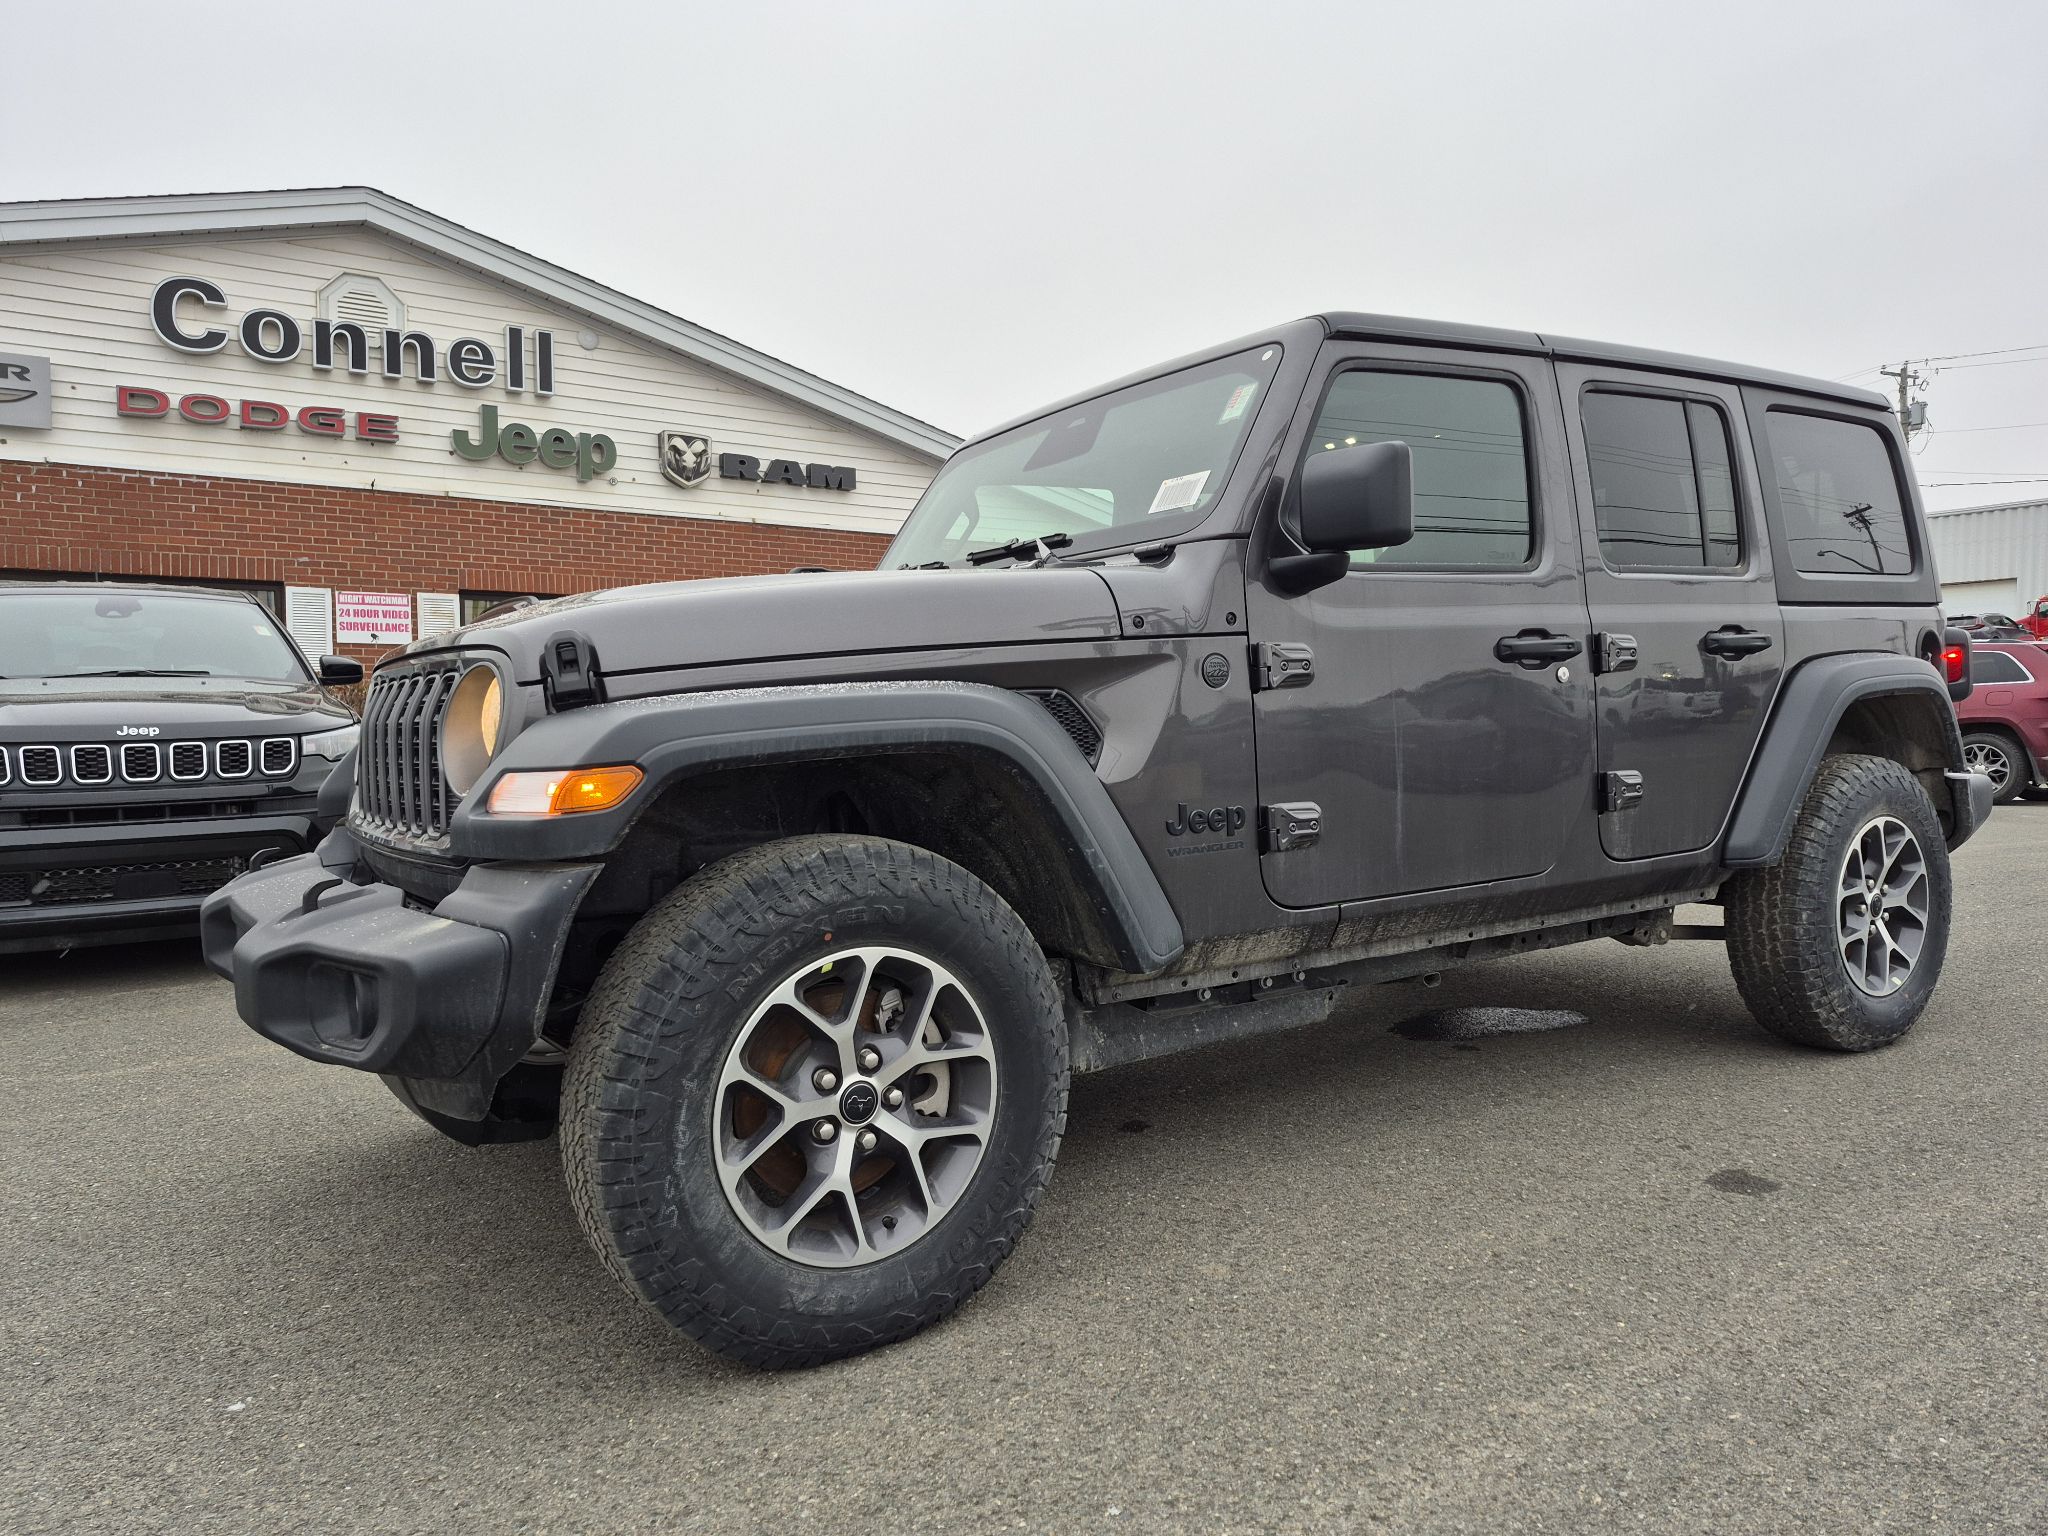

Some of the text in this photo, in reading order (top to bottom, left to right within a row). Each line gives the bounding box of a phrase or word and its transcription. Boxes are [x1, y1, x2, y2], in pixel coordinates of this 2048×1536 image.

[149, 275, 555, 398] Connell
[116, 384, 400, 444] DODGE
[450, 404, 618, 483] Jeep
[719, 452, 857, 491] RAM
[339, 594, 408, 606] NIGHT WATCHMAN
[339, 608, 409, 620] 24 HOUR VIDEO
[339, 621, 410, 633] SURVEILLANCE
[116, 725, 160, 737] Jeep
[1166, 802, 1246, 837] Jeep
[1166, 841, 1245, 858] WRANGLER
